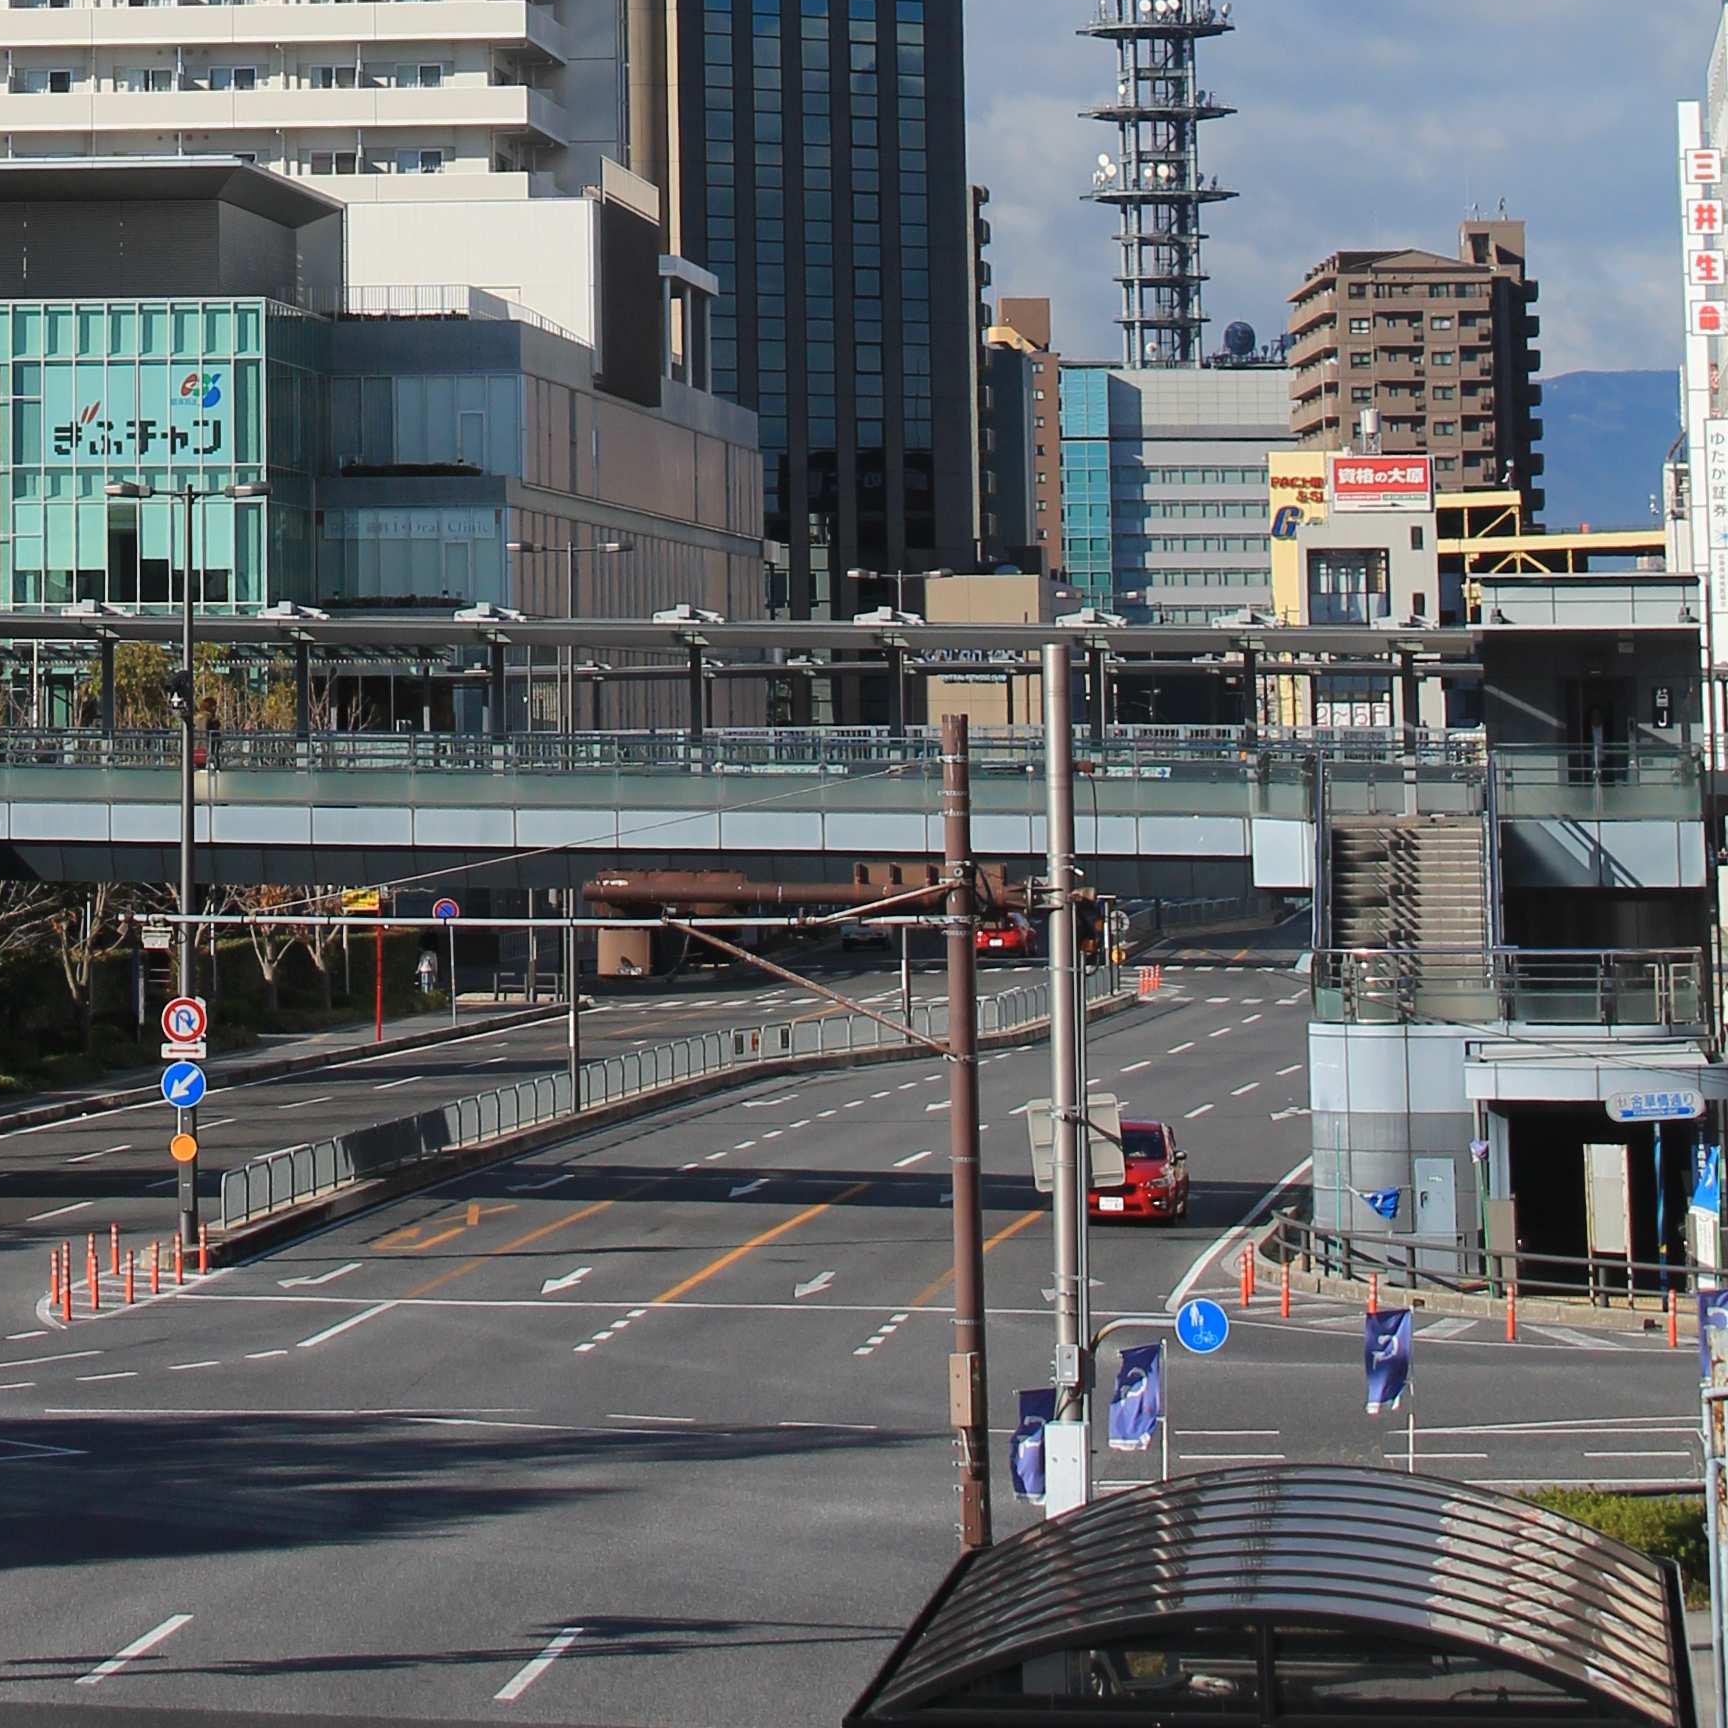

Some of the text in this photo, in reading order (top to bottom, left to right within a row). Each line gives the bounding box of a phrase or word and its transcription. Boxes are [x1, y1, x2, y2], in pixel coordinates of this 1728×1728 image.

[1693, 152, 1721, 331] 三井生命
[54, 400, 222, 456] ぎふチャン
[1338, 467, 1425, 485] 資格の大原
[1710, 431, 1728, 518] ゆたか証券
